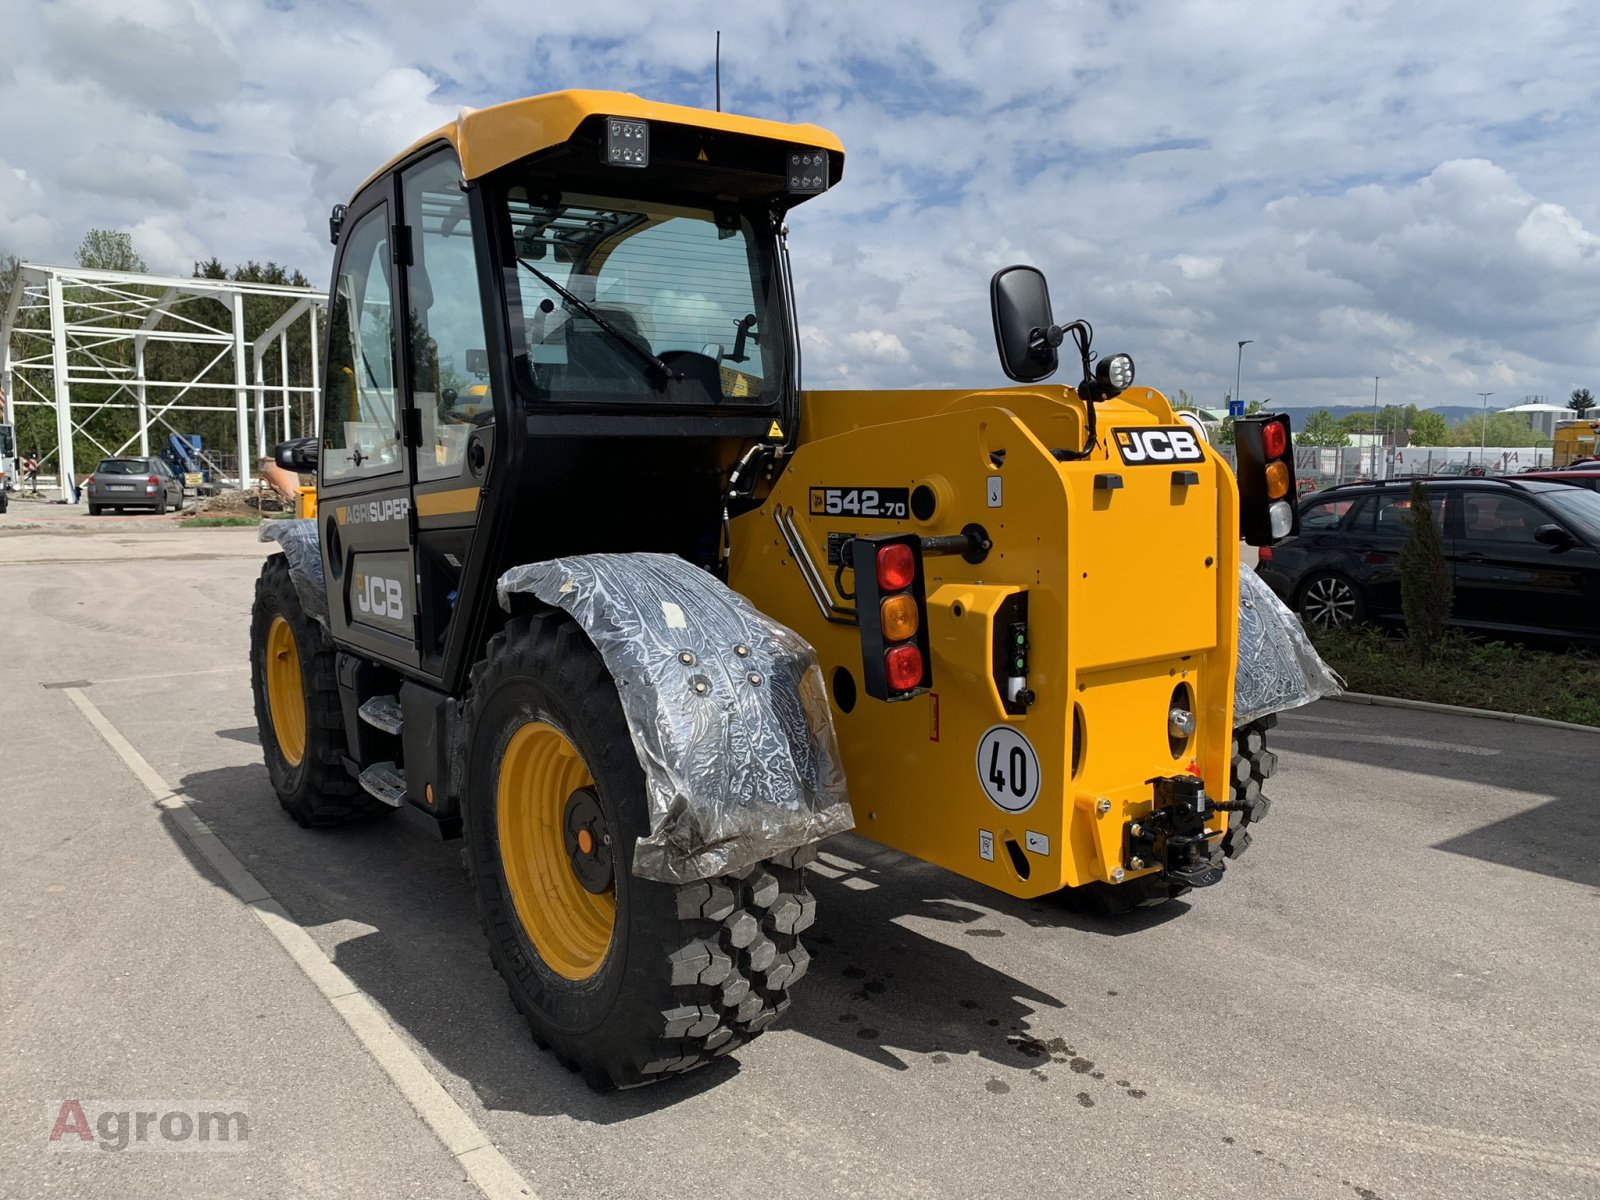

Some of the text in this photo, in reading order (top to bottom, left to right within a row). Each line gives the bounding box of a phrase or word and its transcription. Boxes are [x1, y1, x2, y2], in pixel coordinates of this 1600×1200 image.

[1122, 431, 1200, 461] JCB
[358, 575, 403, 620] JCB
[990, 741, 1027, 797] 40
